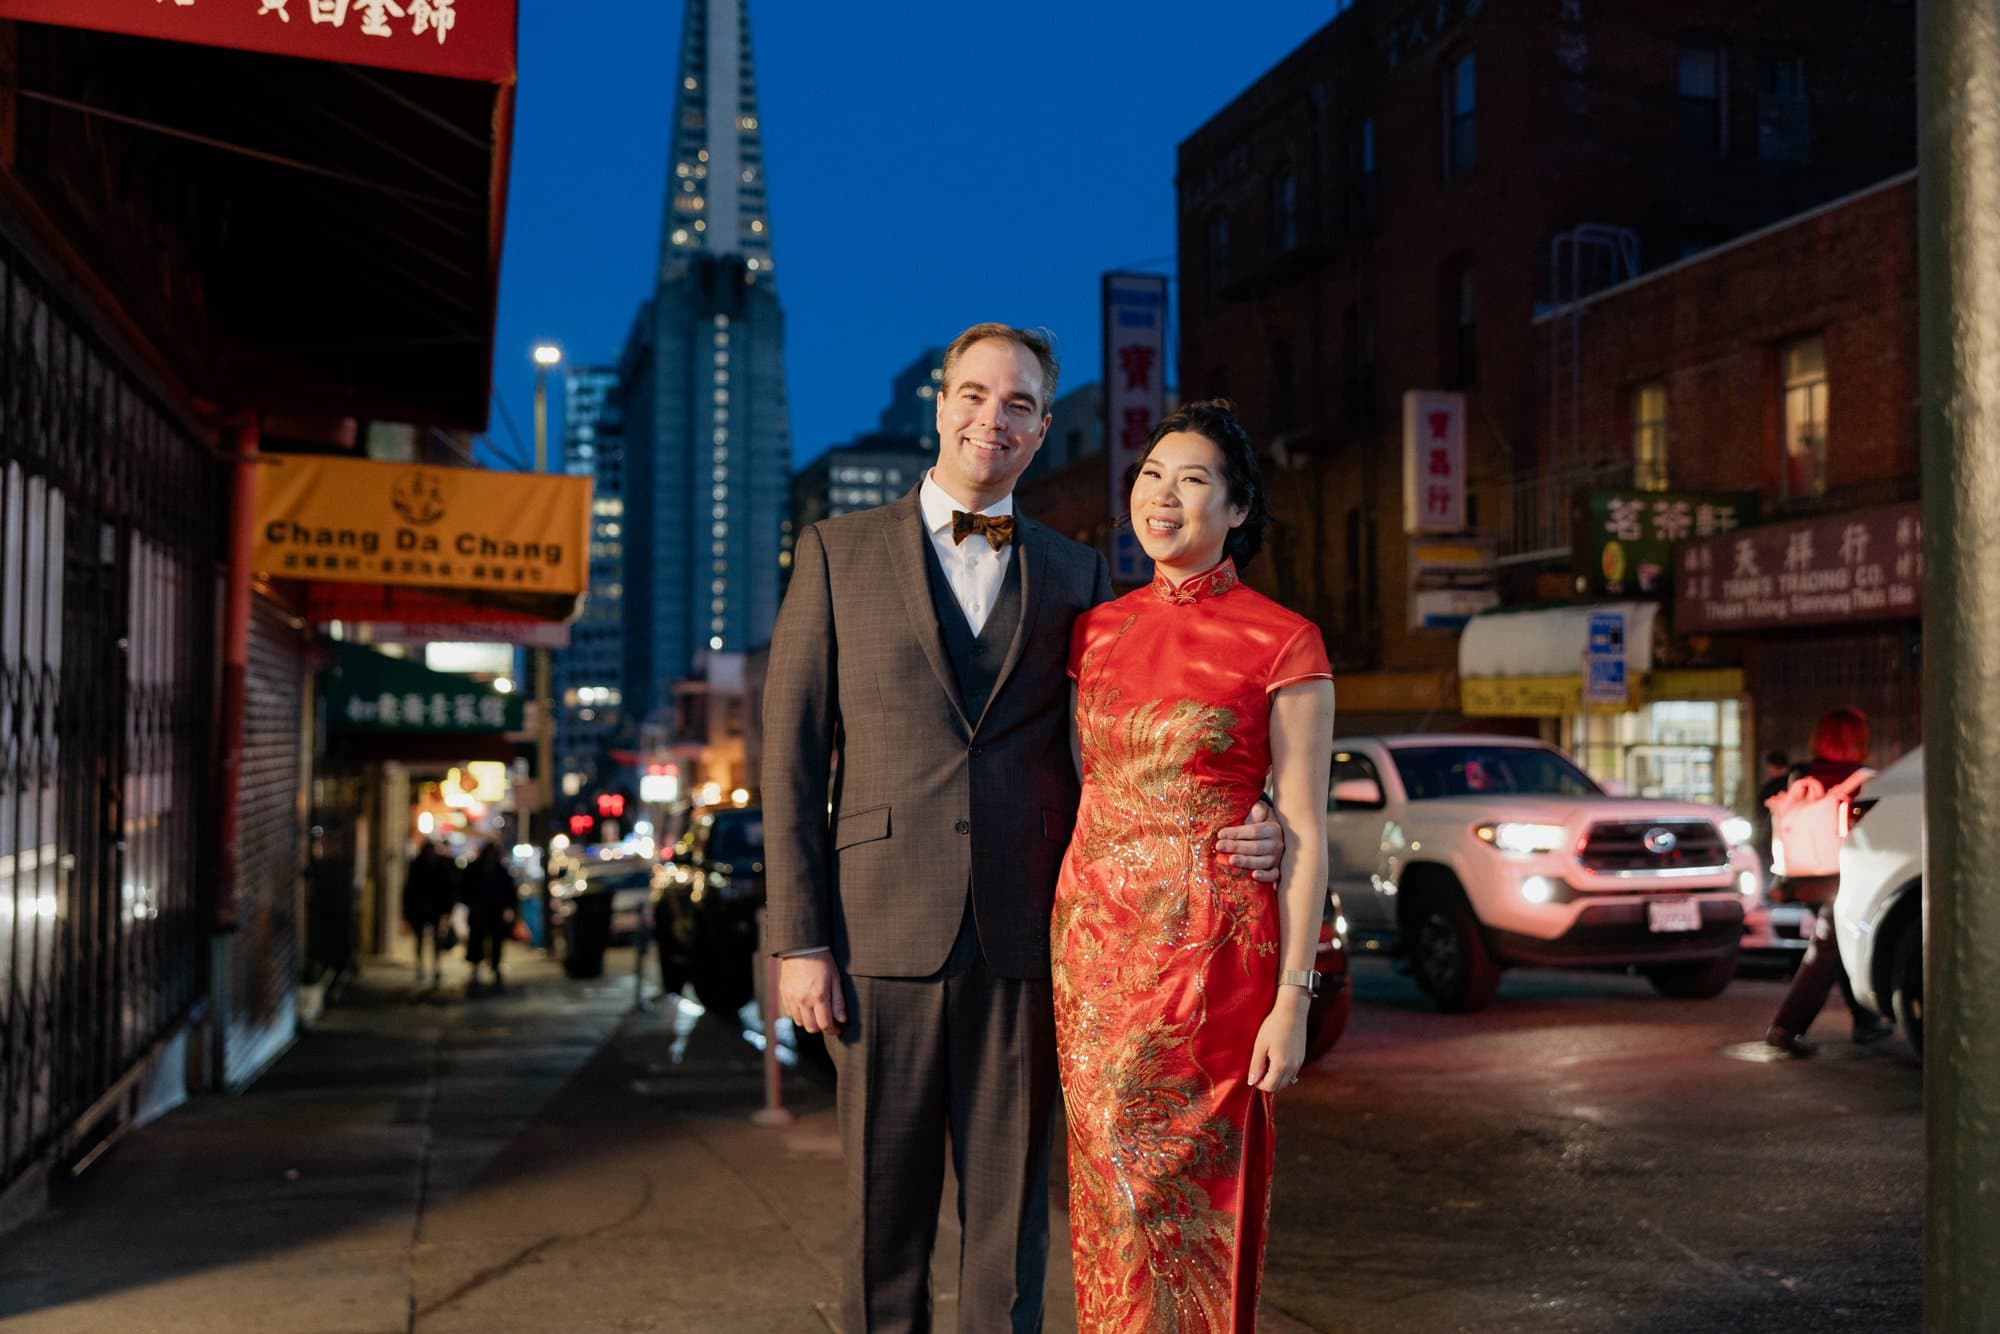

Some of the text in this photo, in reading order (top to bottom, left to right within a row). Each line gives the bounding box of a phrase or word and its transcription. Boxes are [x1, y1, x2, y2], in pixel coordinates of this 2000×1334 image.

[265, 520, 562, 565] Chang Da Chang
[1777, 567, 1849, 592] TRADING
